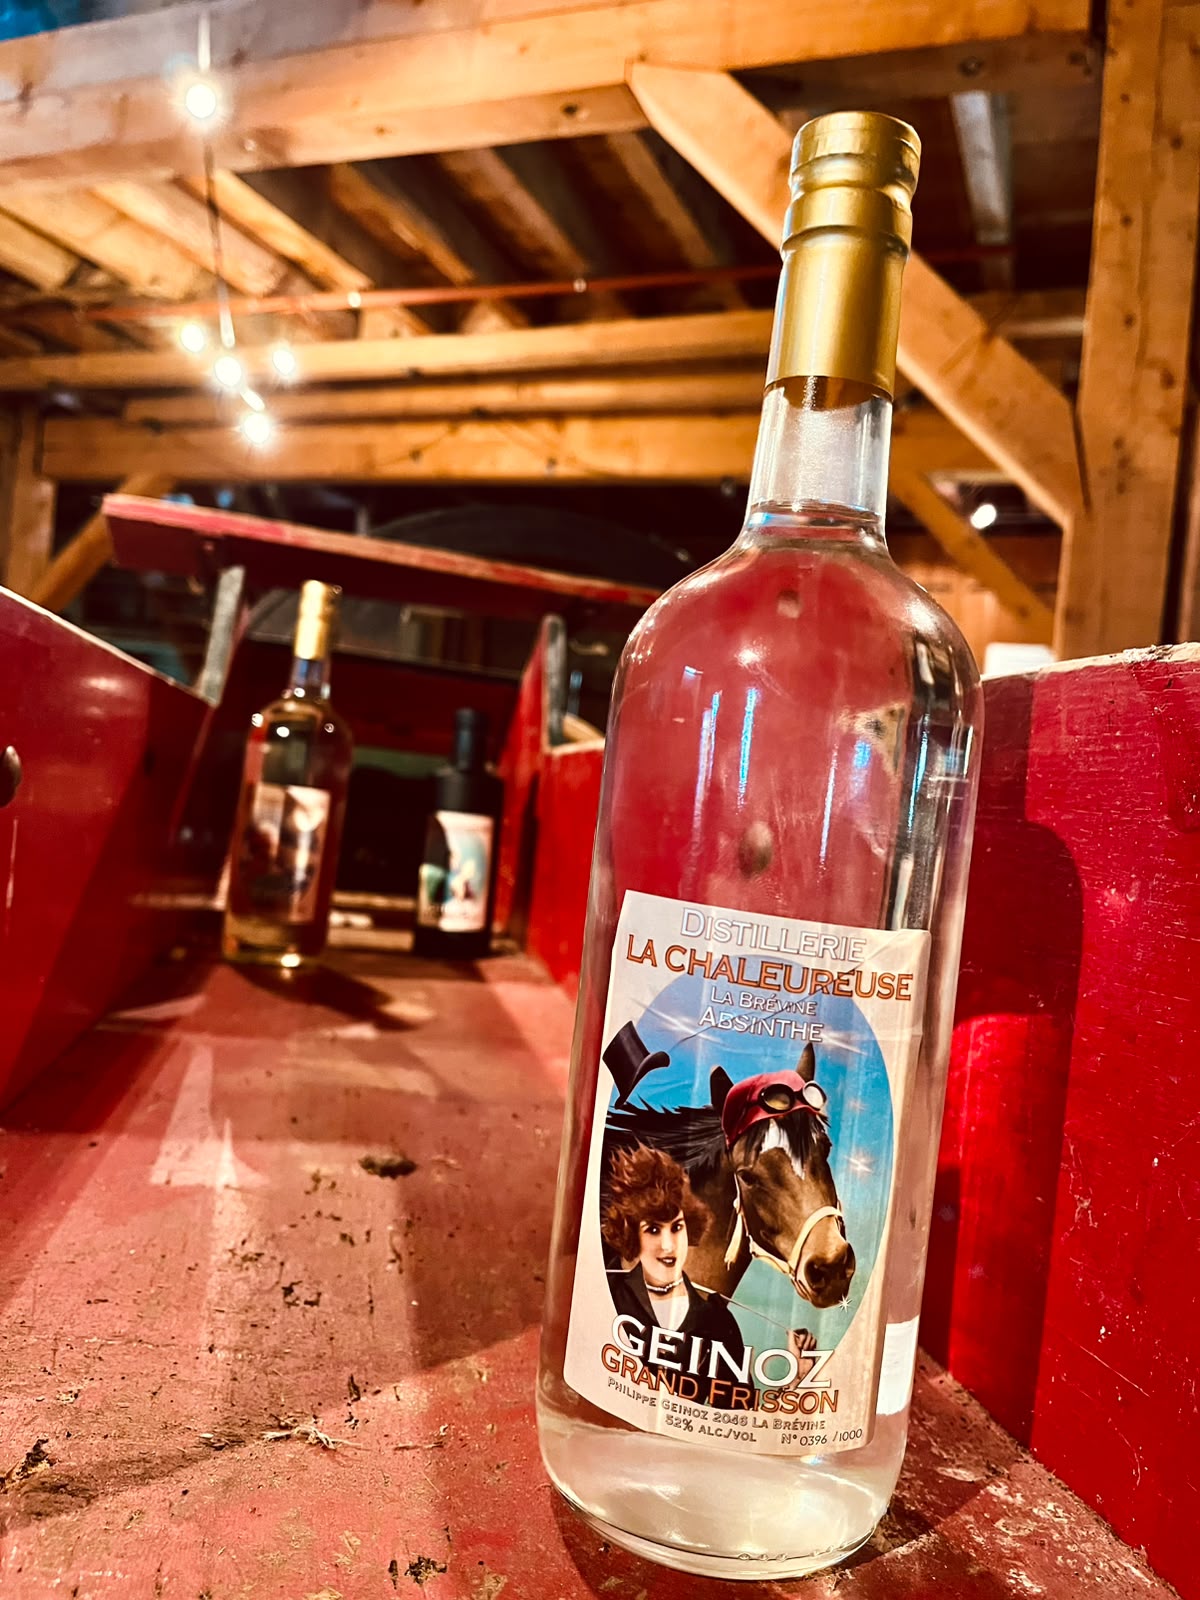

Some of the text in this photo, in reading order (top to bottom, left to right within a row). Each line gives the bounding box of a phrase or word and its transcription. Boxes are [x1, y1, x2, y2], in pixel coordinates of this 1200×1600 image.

[680, 908, 866, 962] DISTILLERIE
[626, 934, 913, 1001] LA CHALEUREUSE
[699, 1006, 824, 1042] ABSINTHE
[710, 987, 817, 1016] LA BRÉVINE
[612, 1314, 835, 1388] GEINOZ
[601, 1344, 839, 1414] GRAND FRISSON
[608, 1376, 657, 1407] PHILIPPE
[661, 1400, 709, 1421] GEINOZ
[752, 1417, 769, 1429] LA
[772, 1418, 826, 1431] BRÉVINE
[665, 1413, 694, 1433] 52%
[799, 1434, 828, 1446] 0396
